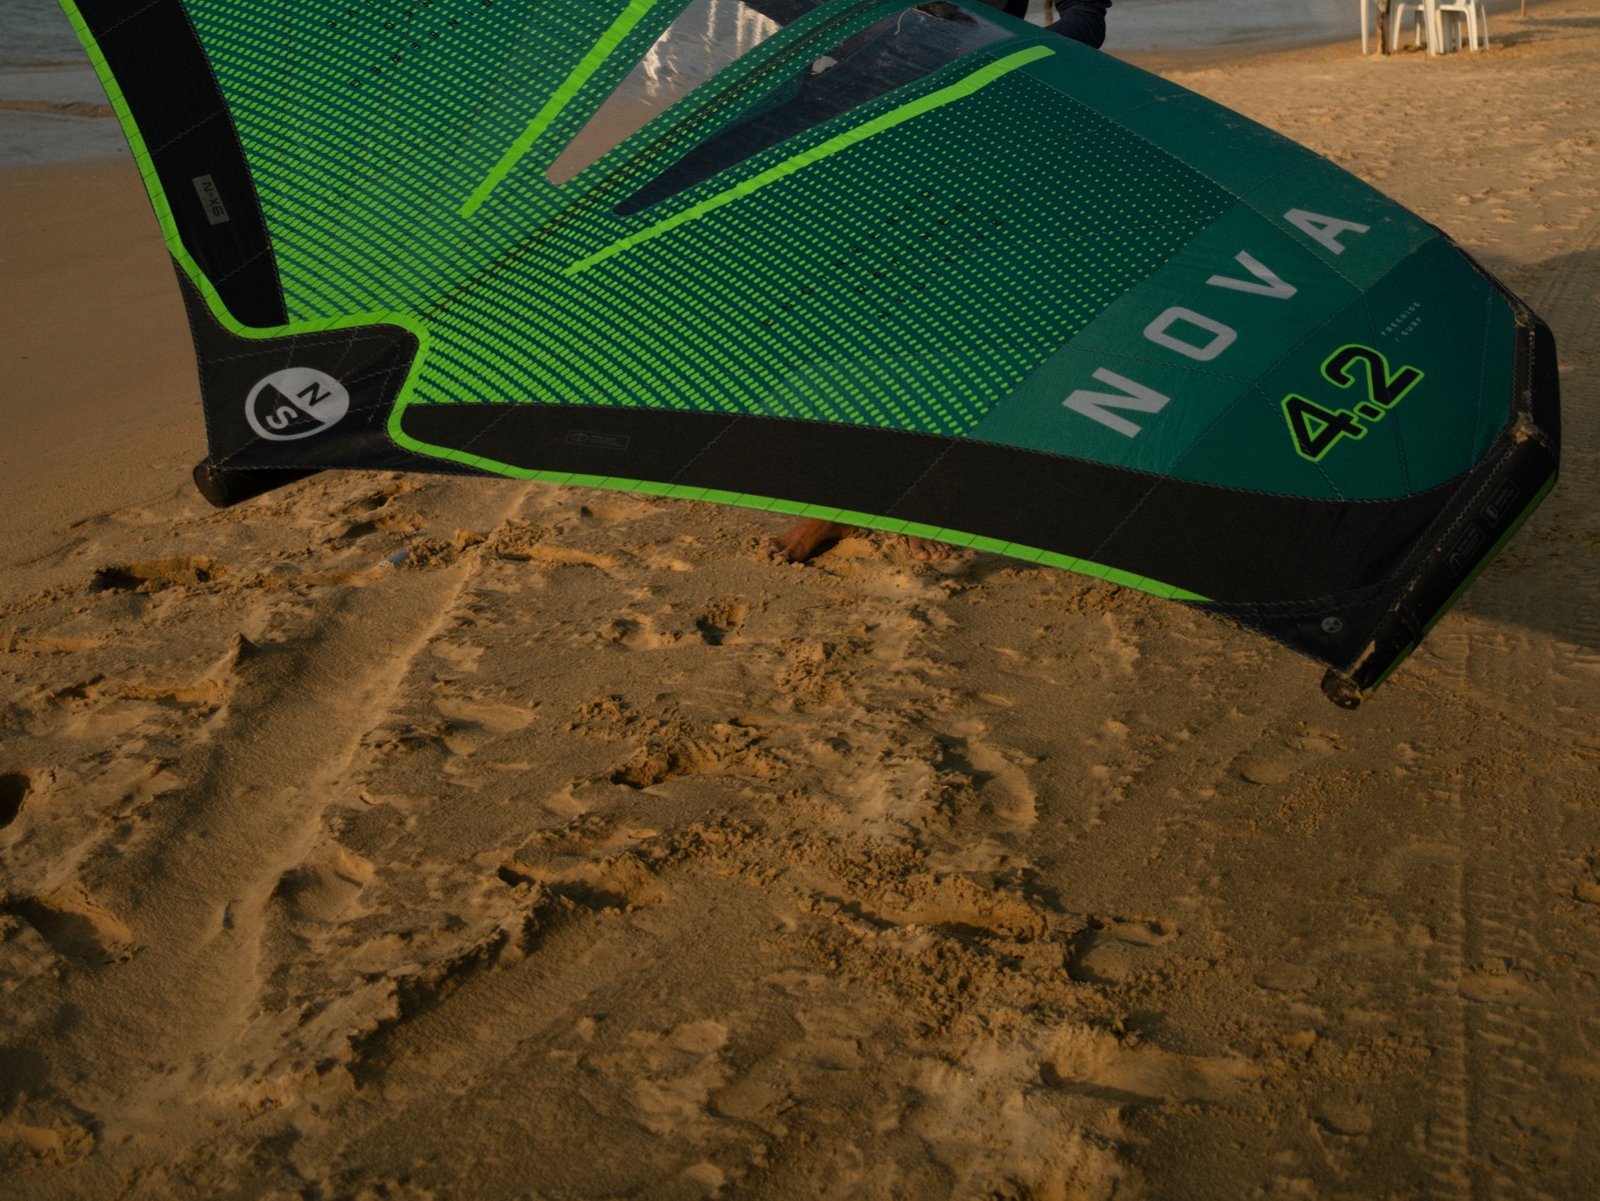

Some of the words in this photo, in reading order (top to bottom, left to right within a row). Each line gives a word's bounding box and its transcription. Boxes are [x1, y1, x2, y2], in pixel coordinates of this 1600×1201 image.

[1062, 208, 1371, 439] NOVA
[267, 407, 298, 430] S
[297, 382, 332, 407] N
[1281, 343, 1425, 463] 4.2
